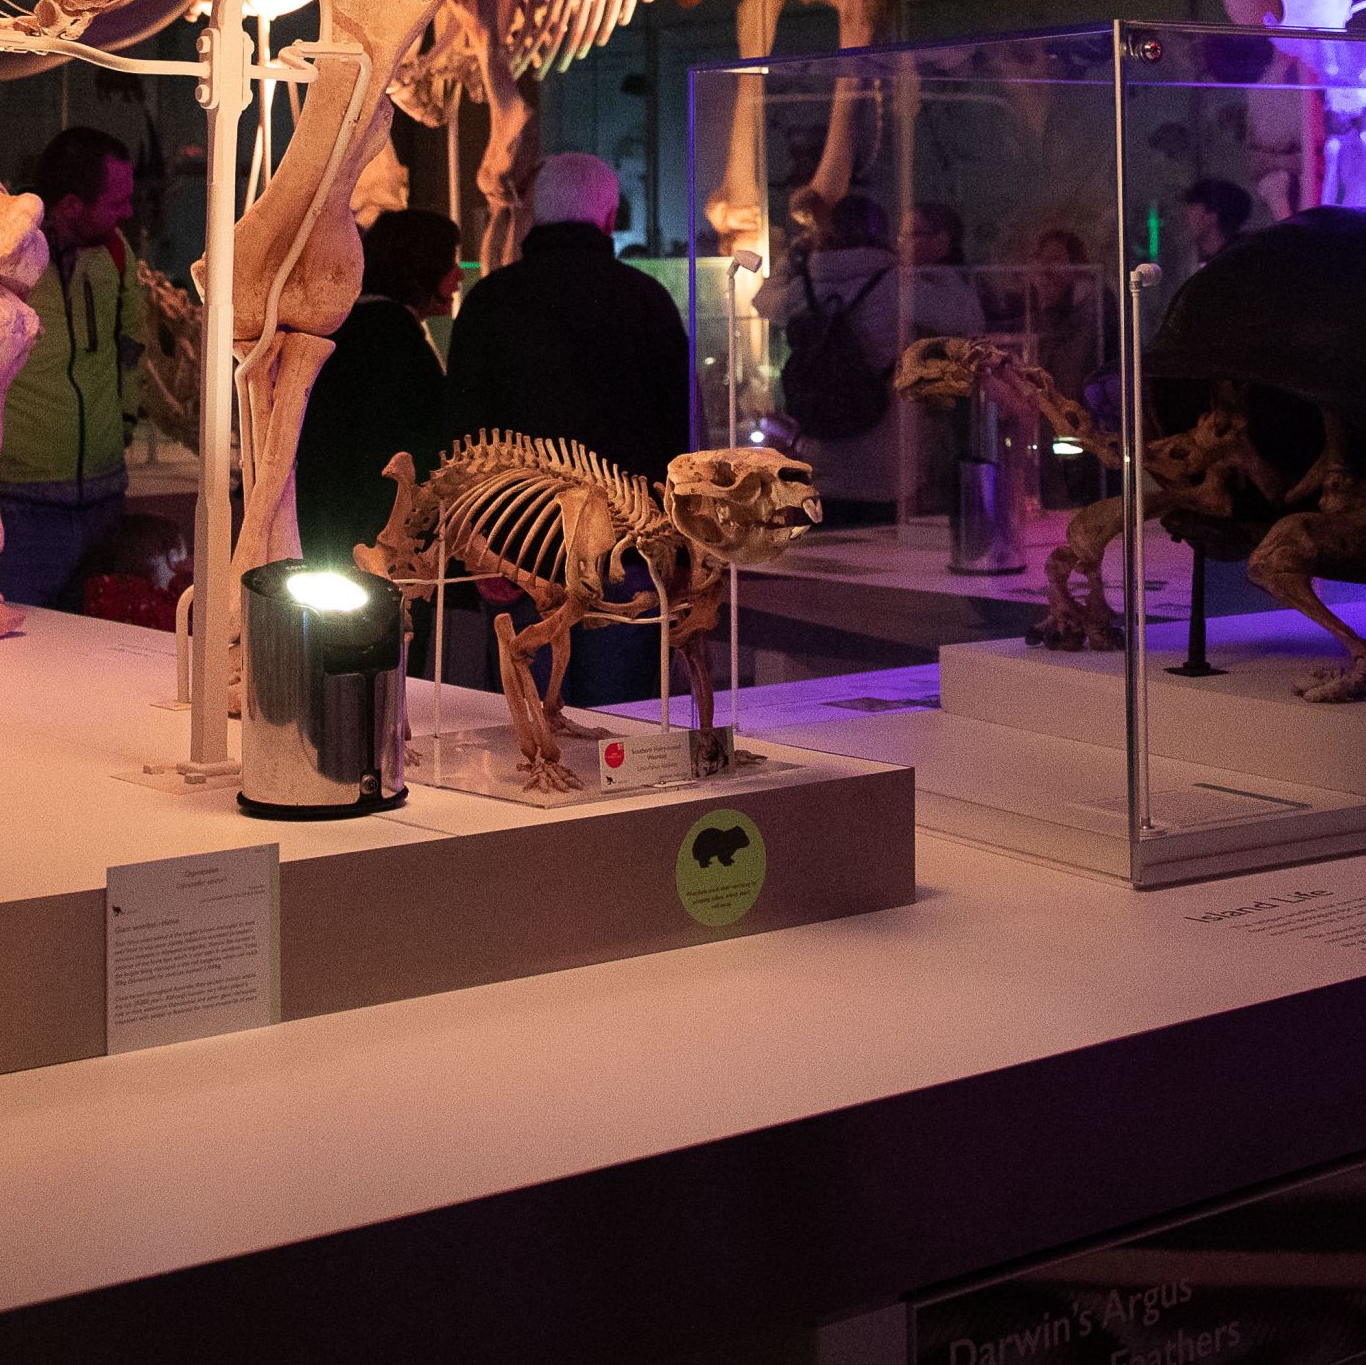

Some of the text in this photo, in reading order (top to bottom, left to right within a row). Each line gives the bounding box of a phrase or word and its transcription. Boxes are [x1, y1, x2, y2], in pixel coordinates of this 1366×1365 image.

[1184, 890, 1335, 923] Island Life
[949, 1277, 1193, 1365] Darwin's Argus
